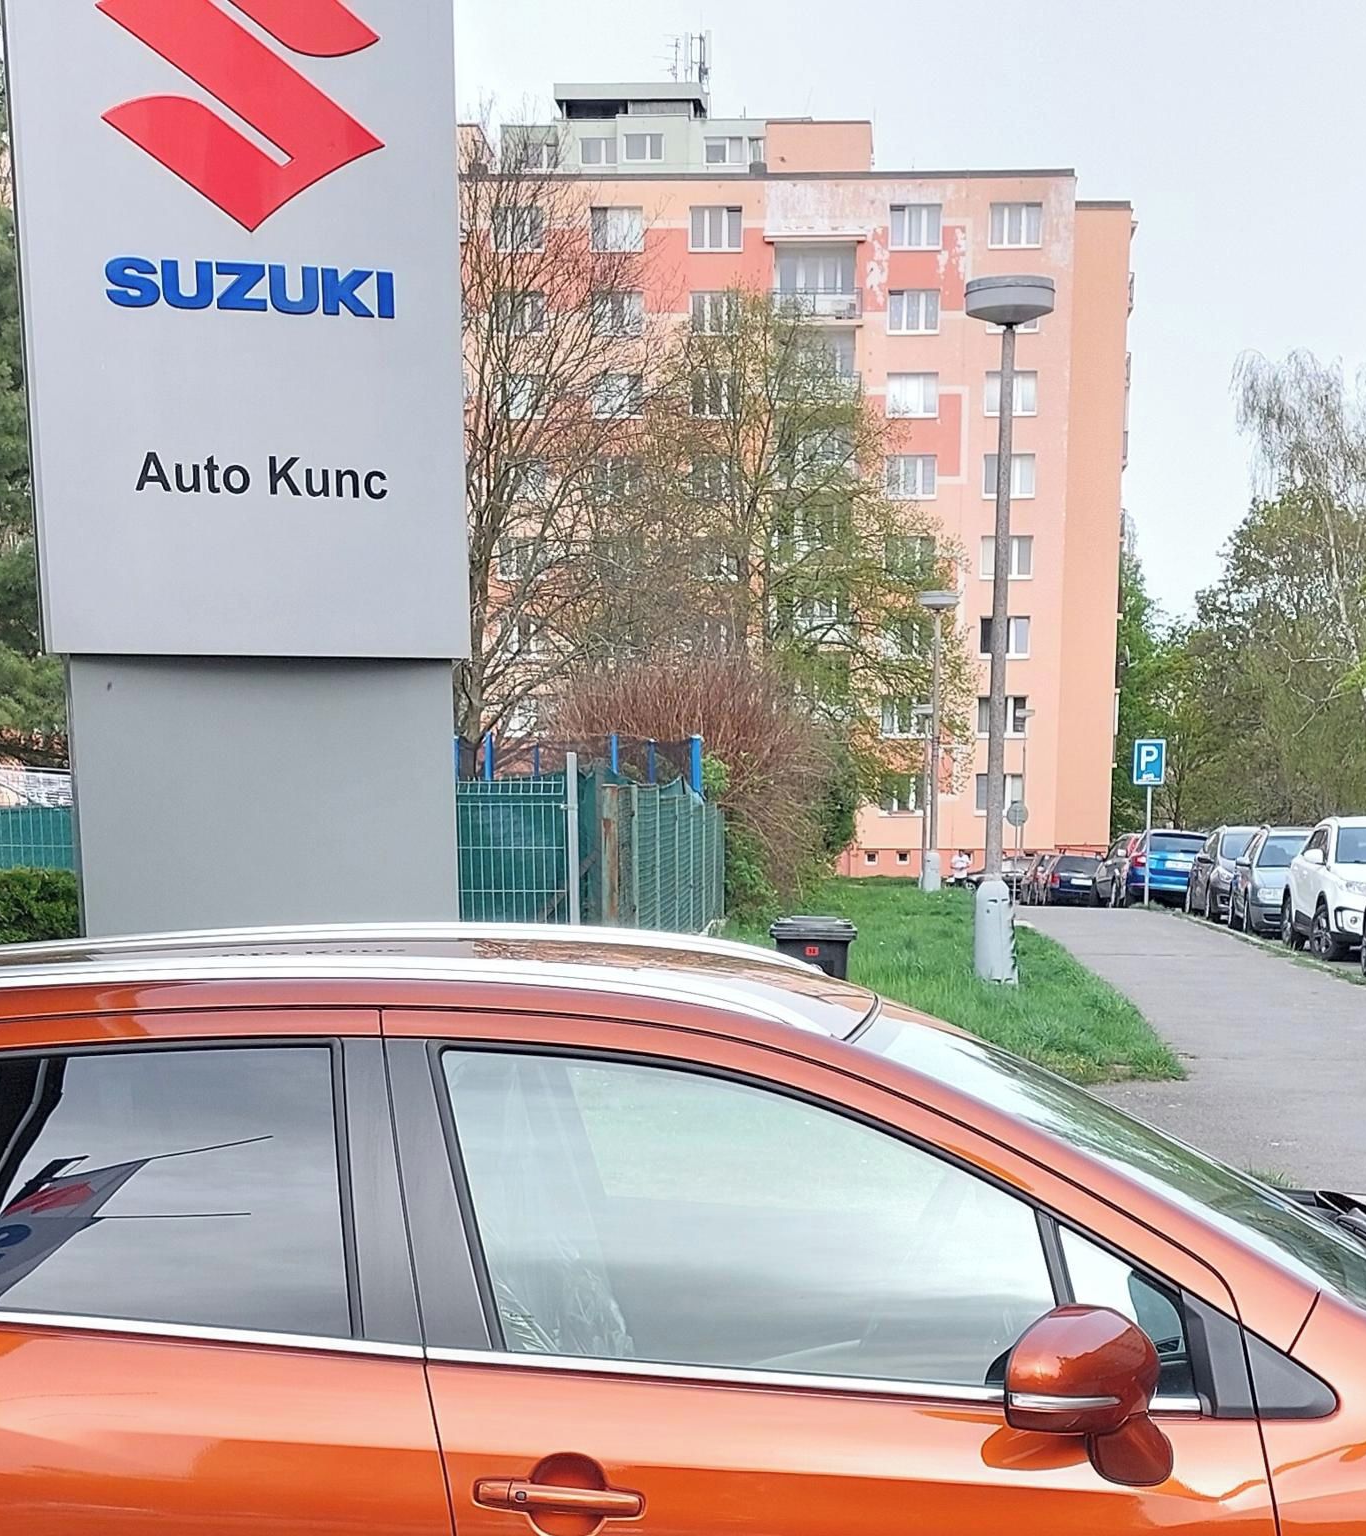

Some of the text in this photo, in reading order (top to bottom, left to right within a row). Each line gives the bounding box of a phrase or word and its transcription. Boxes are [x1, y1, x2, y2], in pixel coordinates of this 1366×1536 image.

[104, 256, 395, 319] SUZUKI
[135, 451, 388, 500] Auto Kunc
[1140, 745, 1159, 772] P
